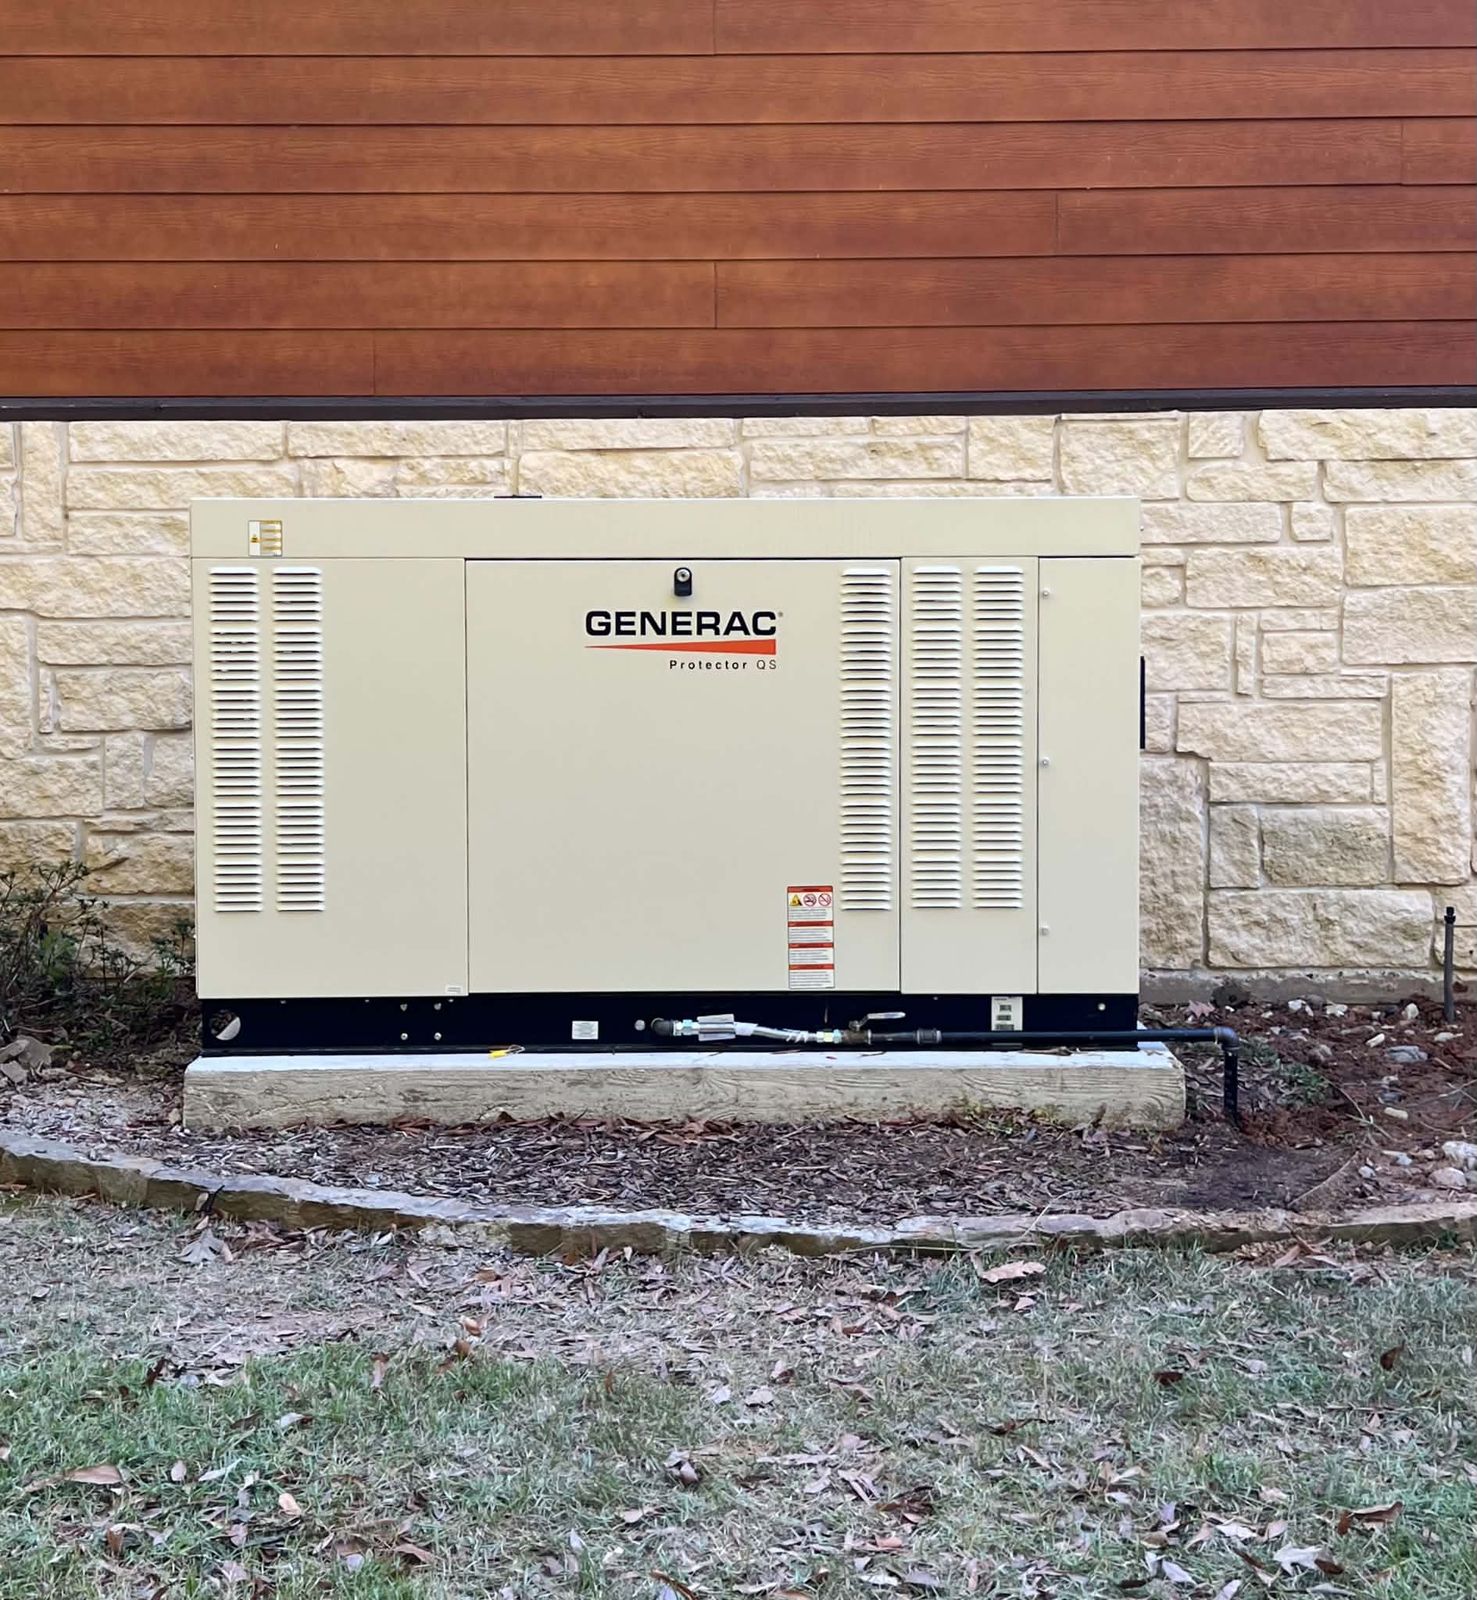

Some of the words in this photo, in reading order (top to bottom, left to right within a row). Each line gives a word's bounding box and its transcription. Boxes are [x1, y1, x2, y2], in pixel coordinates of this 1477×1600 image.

[585, 610, 777, 636] GENERAC
[669, 659, 748, 670] Protector
[756, 659, 777, 670] QS
